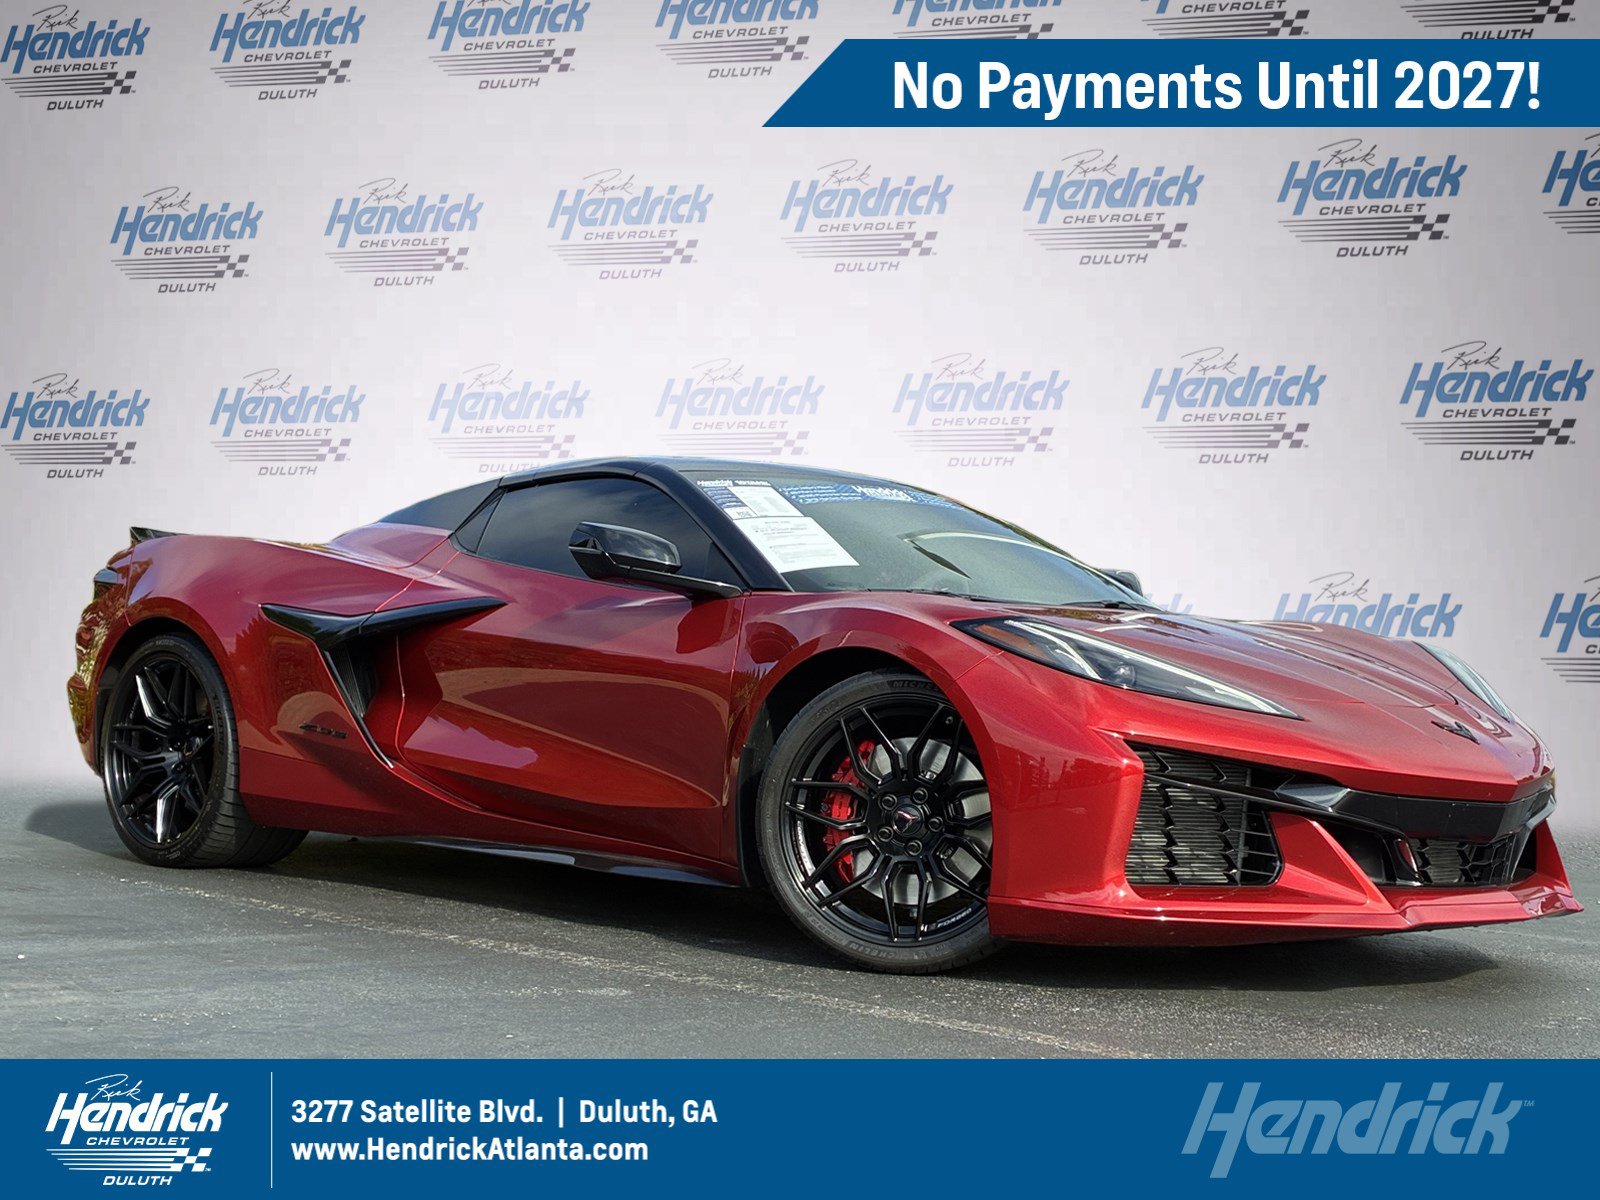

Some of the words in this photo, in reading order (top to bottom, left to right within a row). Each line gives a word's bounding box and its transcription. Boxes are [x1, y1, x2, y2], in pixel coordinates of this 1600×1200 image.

[1181, 0, 1287, 14] CHEVROLET
[427, 0, 590, 51] Hendrick
[931, 13, 1032, 27] CHEVROLET
[209, 6, 366, 63] Hendrick
[692, 26, 788, 39] CHEVROLET
[0, 18, 150, 74] Hendrick
[463, 38, 556, 51] CHEVROLET
[244, 50, 332, 63] CHEVROLET
[32, 61, 118, 74] CHEVROLET
[707, 66, 773, 79] DULUTH
[478, 77, 540, 90] DULUTH
[257, 88, 318, 101] DULUTH
[46, 99, 104, 111] DULUTH
[1276, 154, 1468, 216] Hendrick
[1022, 165, 1205, 224] Hendrick
[779, 175, 954, 232] Hendrick
[1319, 203, 1427, 216] CHEVROLET
[547, 184, 713, 241] Hendrick
[1062, 212, 1165, 225] CHEVROLET
[323, 193, 484, 248] Hendrick
[818, 221, 916, 233] CHEVROLET
[110, 201, 264, 256] Hendrick
[584, 229, 678, 241] CHEVROLET
[359, 237, 450, 248] CHEVROLET
[143, 244, 231, 256] CHEVROLET
[1336, 245, 1409, 258] DULUTH
[1079, 253, 1148, 266] DULUTH
[833, 261, 900, 273] DULUTH
[599, 268, 662, 280] DULUTH
[158, 282, 216, 294] DULUTH
[373, 276, 434, 287] DULUTH
[1141, 364, 1327, 422] Hendrick
[1399, 359, 1594, 418] Hendrick
[655, 375, 825, 430] Hendrick
[892, 370, 1070, 426] Hendrick
[209, 385, 366, 437] Hendrick
[427, 380, 590, 434] Hendrick
[1442, 408, 1552, 418] CHEVROLET
[0, 389, 150, 441] Hendrick
[931, 416, 1031, 426] CHEVROLET
[1182, 412, 1286, 423] CHEVROLET
[463, 424, 556, 434] CHEVROLET
[692, 420, 788, 430] CHEVROLET
[32, 432, 118, 441] CHEVROLET
[244, 428, 332, 438] CHEVROLET
[947, 456, 1015, 468] DULUTH
[1198, 453, 1269, 464] DULUTH
[1460, 450, 1534, 461] DULUTH
[46, 469, 104, 479] DULUTH
[257, 466, 318, 476] DULUTH
